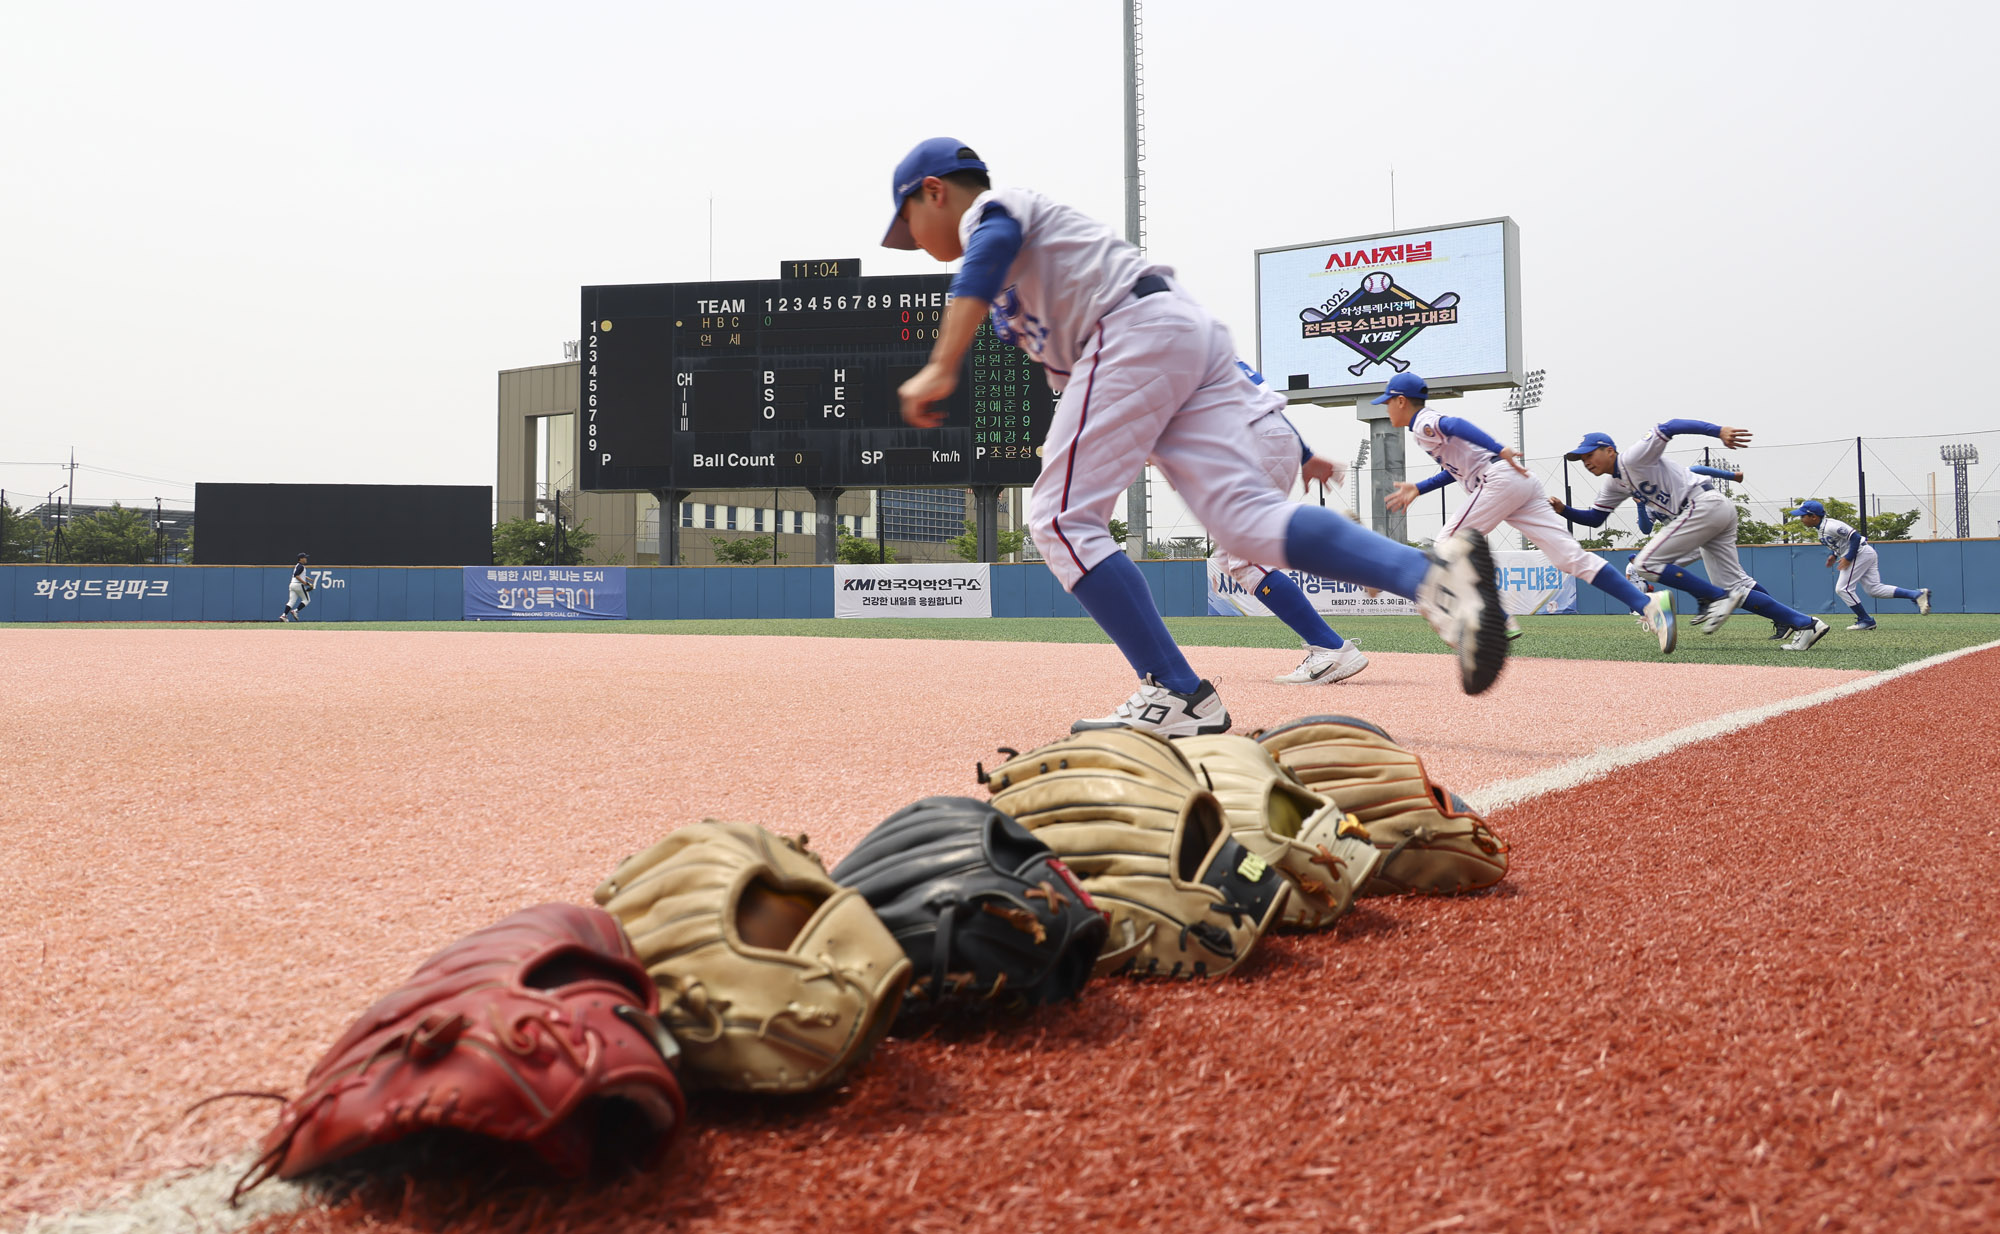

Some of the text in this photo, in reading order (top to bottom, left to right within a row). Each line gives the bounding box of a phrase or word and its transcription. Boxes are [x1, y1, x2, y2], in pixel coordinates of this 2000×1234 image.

[1325, 241, 1432, 270] 시사저널
[792, 262, 839, 278] 11:04
[697, 299, 745, 313] TEAM
[1320, 287, 1350, 313] 2025
[590, 320, 597, 333] 1
[1303, 308, 1456, 337] 전국유소년야구대회
[589, 335, 597, 348] 2
[1359, 330, 1402, 344] KYBF
[589, 350, 597, 362] 3
[589, 365, 597, 377] 4
[763, 371, 775, 384] B
[834, 369, 846, 382] H
[677, 372, 693, 386] CH
[589, 380, 597, 392] 5
[764, 388, 775, 402] S
[834, 386, 845, 400] E
[589, 395, 597, 407] 6
[589, 409, 597, 421] 7
[763, 406, 775, 419] O
[823, 404, 846, 418] FC
[589, 424, 597, 436] 8
[588, 439, 597, 451] 9
[602, 454, 612, 466] P
[693, 454, 724, 467] Ball
[727, 453, 775, 467] Count
[861, 450, 961, 465] SP Km/h
[976, 447, 986, 460] P
[310, 571, 345, 589] 75m
[486, 570, 519, 582] 특별한
[549, 570, 580, 582] 빛나는
[582, 571, 604, 582] 도시
[1494, 565, 1563, 592] 야구대회
[33, 579, 169, 600] 화성드림파크
[843, 578, 981, 591] KMI 한국의학연구소
[862, 596, 963, 606] 건강한 내일을 응원합니다
